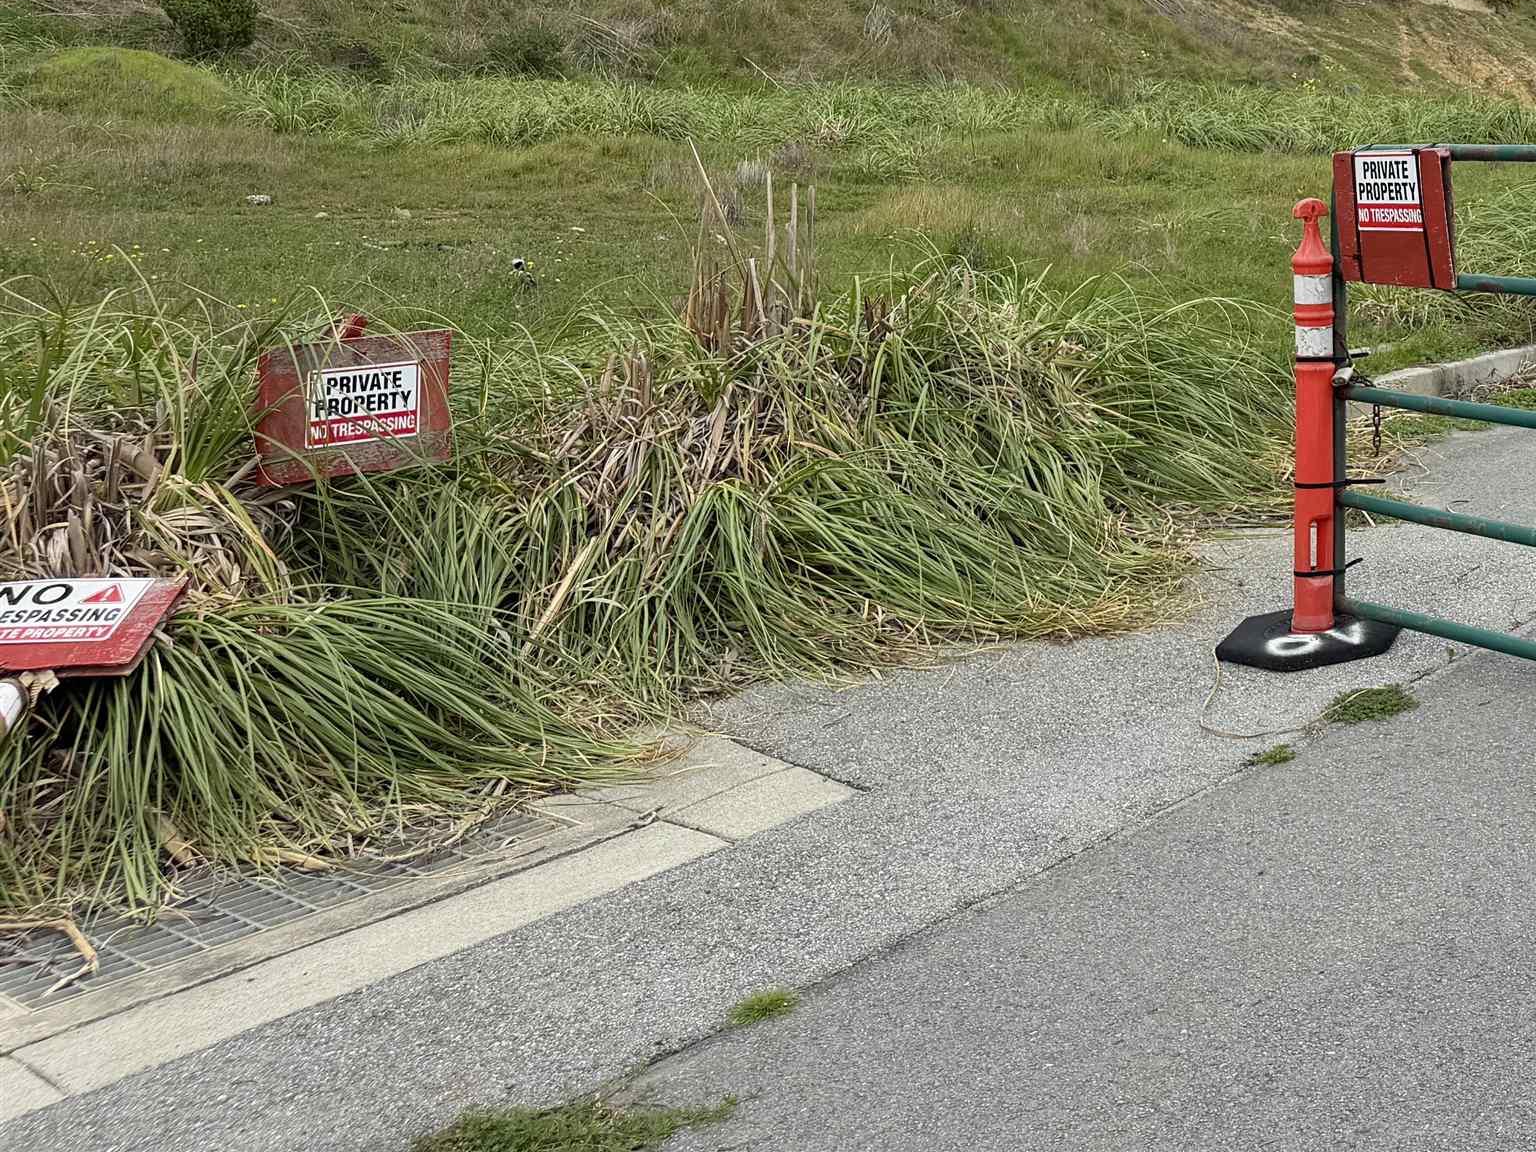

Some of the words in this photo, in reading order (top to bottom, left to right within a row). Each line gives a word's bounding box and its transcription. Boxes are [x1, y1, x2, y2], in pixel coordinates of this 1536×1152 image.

[1363, 161, 1409, 179] PRIVATE
[1358, 182, 1416, 201] PROPERTY
[1358, 208, 1369, 222] NO
[1371, 208, 1422, 223] TRESPASSING
[326, 371, 402, 395] PRIVATE
[315, 390, 412, 418] PROPERTY
[311, 425, 327, 440] NO
[331, 415, 415, 436] TRESPASSING
[0, 584, 73, 605] NO
[22, 627, 107, 639] PROPERTY
